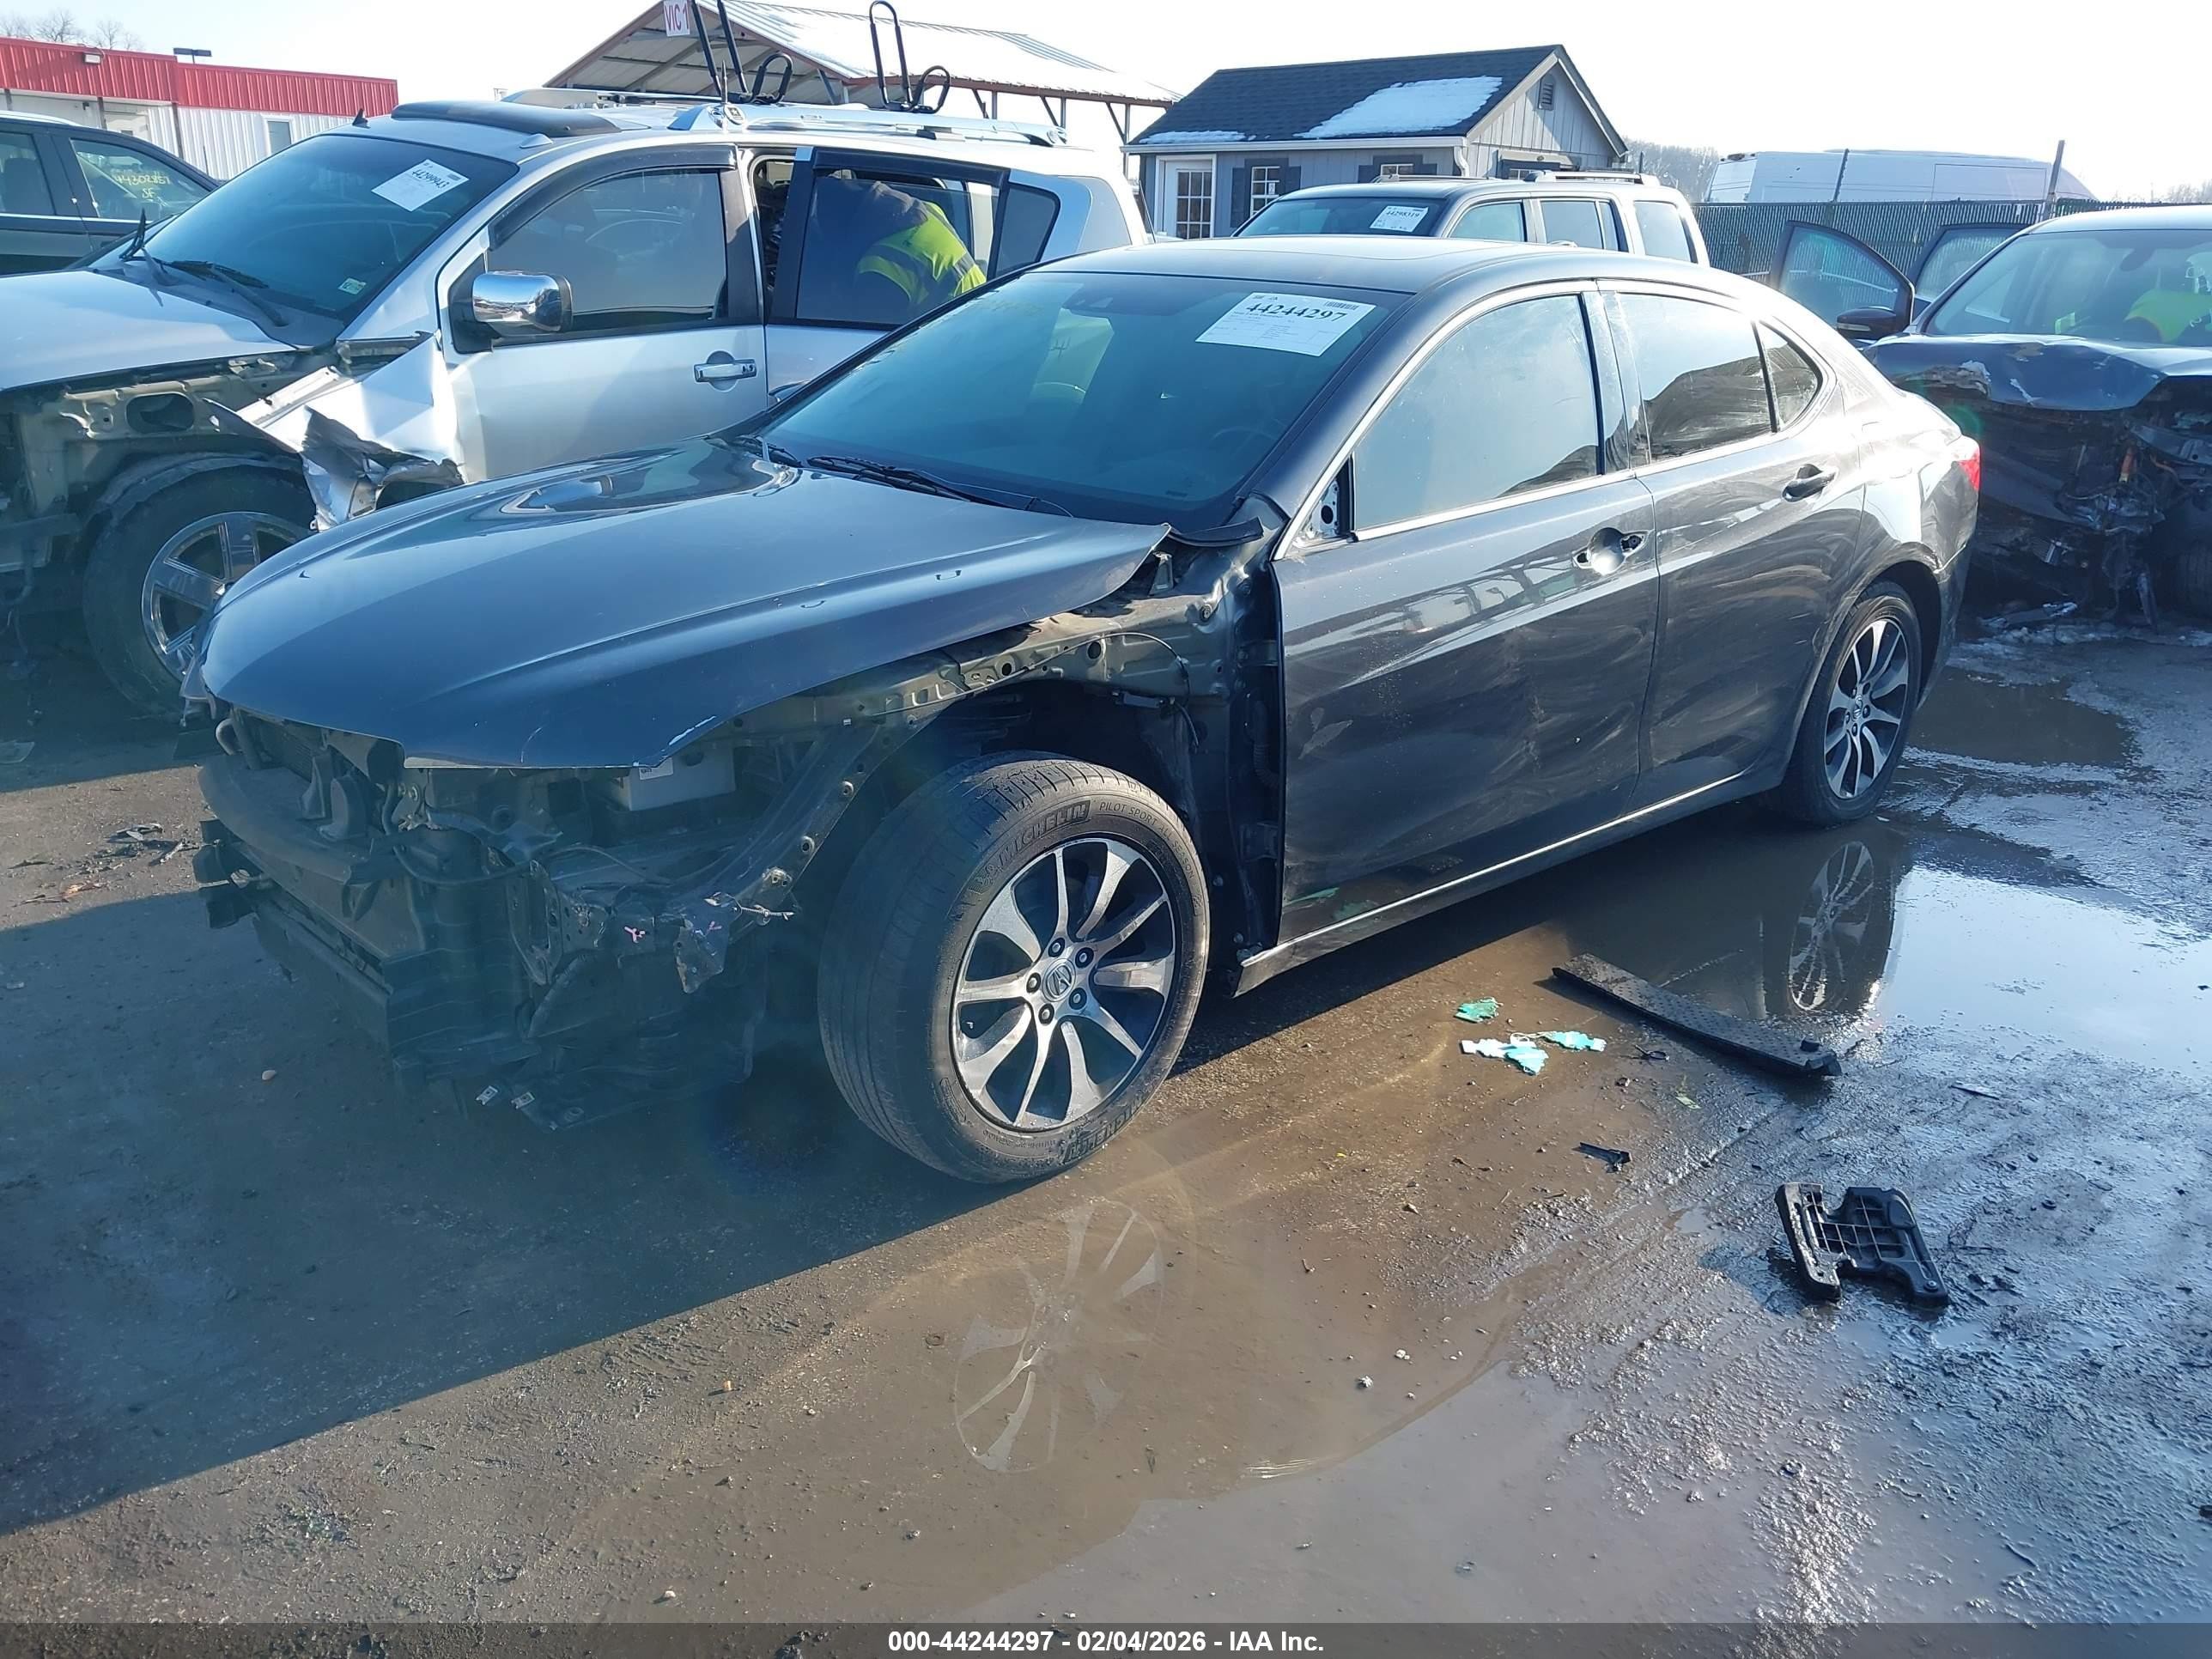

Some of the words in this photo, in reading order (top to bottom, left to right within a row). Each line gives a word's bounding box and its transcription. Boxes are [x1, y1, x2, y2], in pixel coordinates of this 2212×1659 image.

[665, 3, 682, 31] VIC
[682, 3, 690, 30] 1
[1246, 303, 1346, 322] 44244297
[998, 803, 1088, 867] MICHELIN
[1099, 801, 1127, 812] PILOT
[1128, 807, 1158, 825] SPORT
[1159, 825, 1173, 841] ALL
[1172, 841, 1195, 878] SEASON
